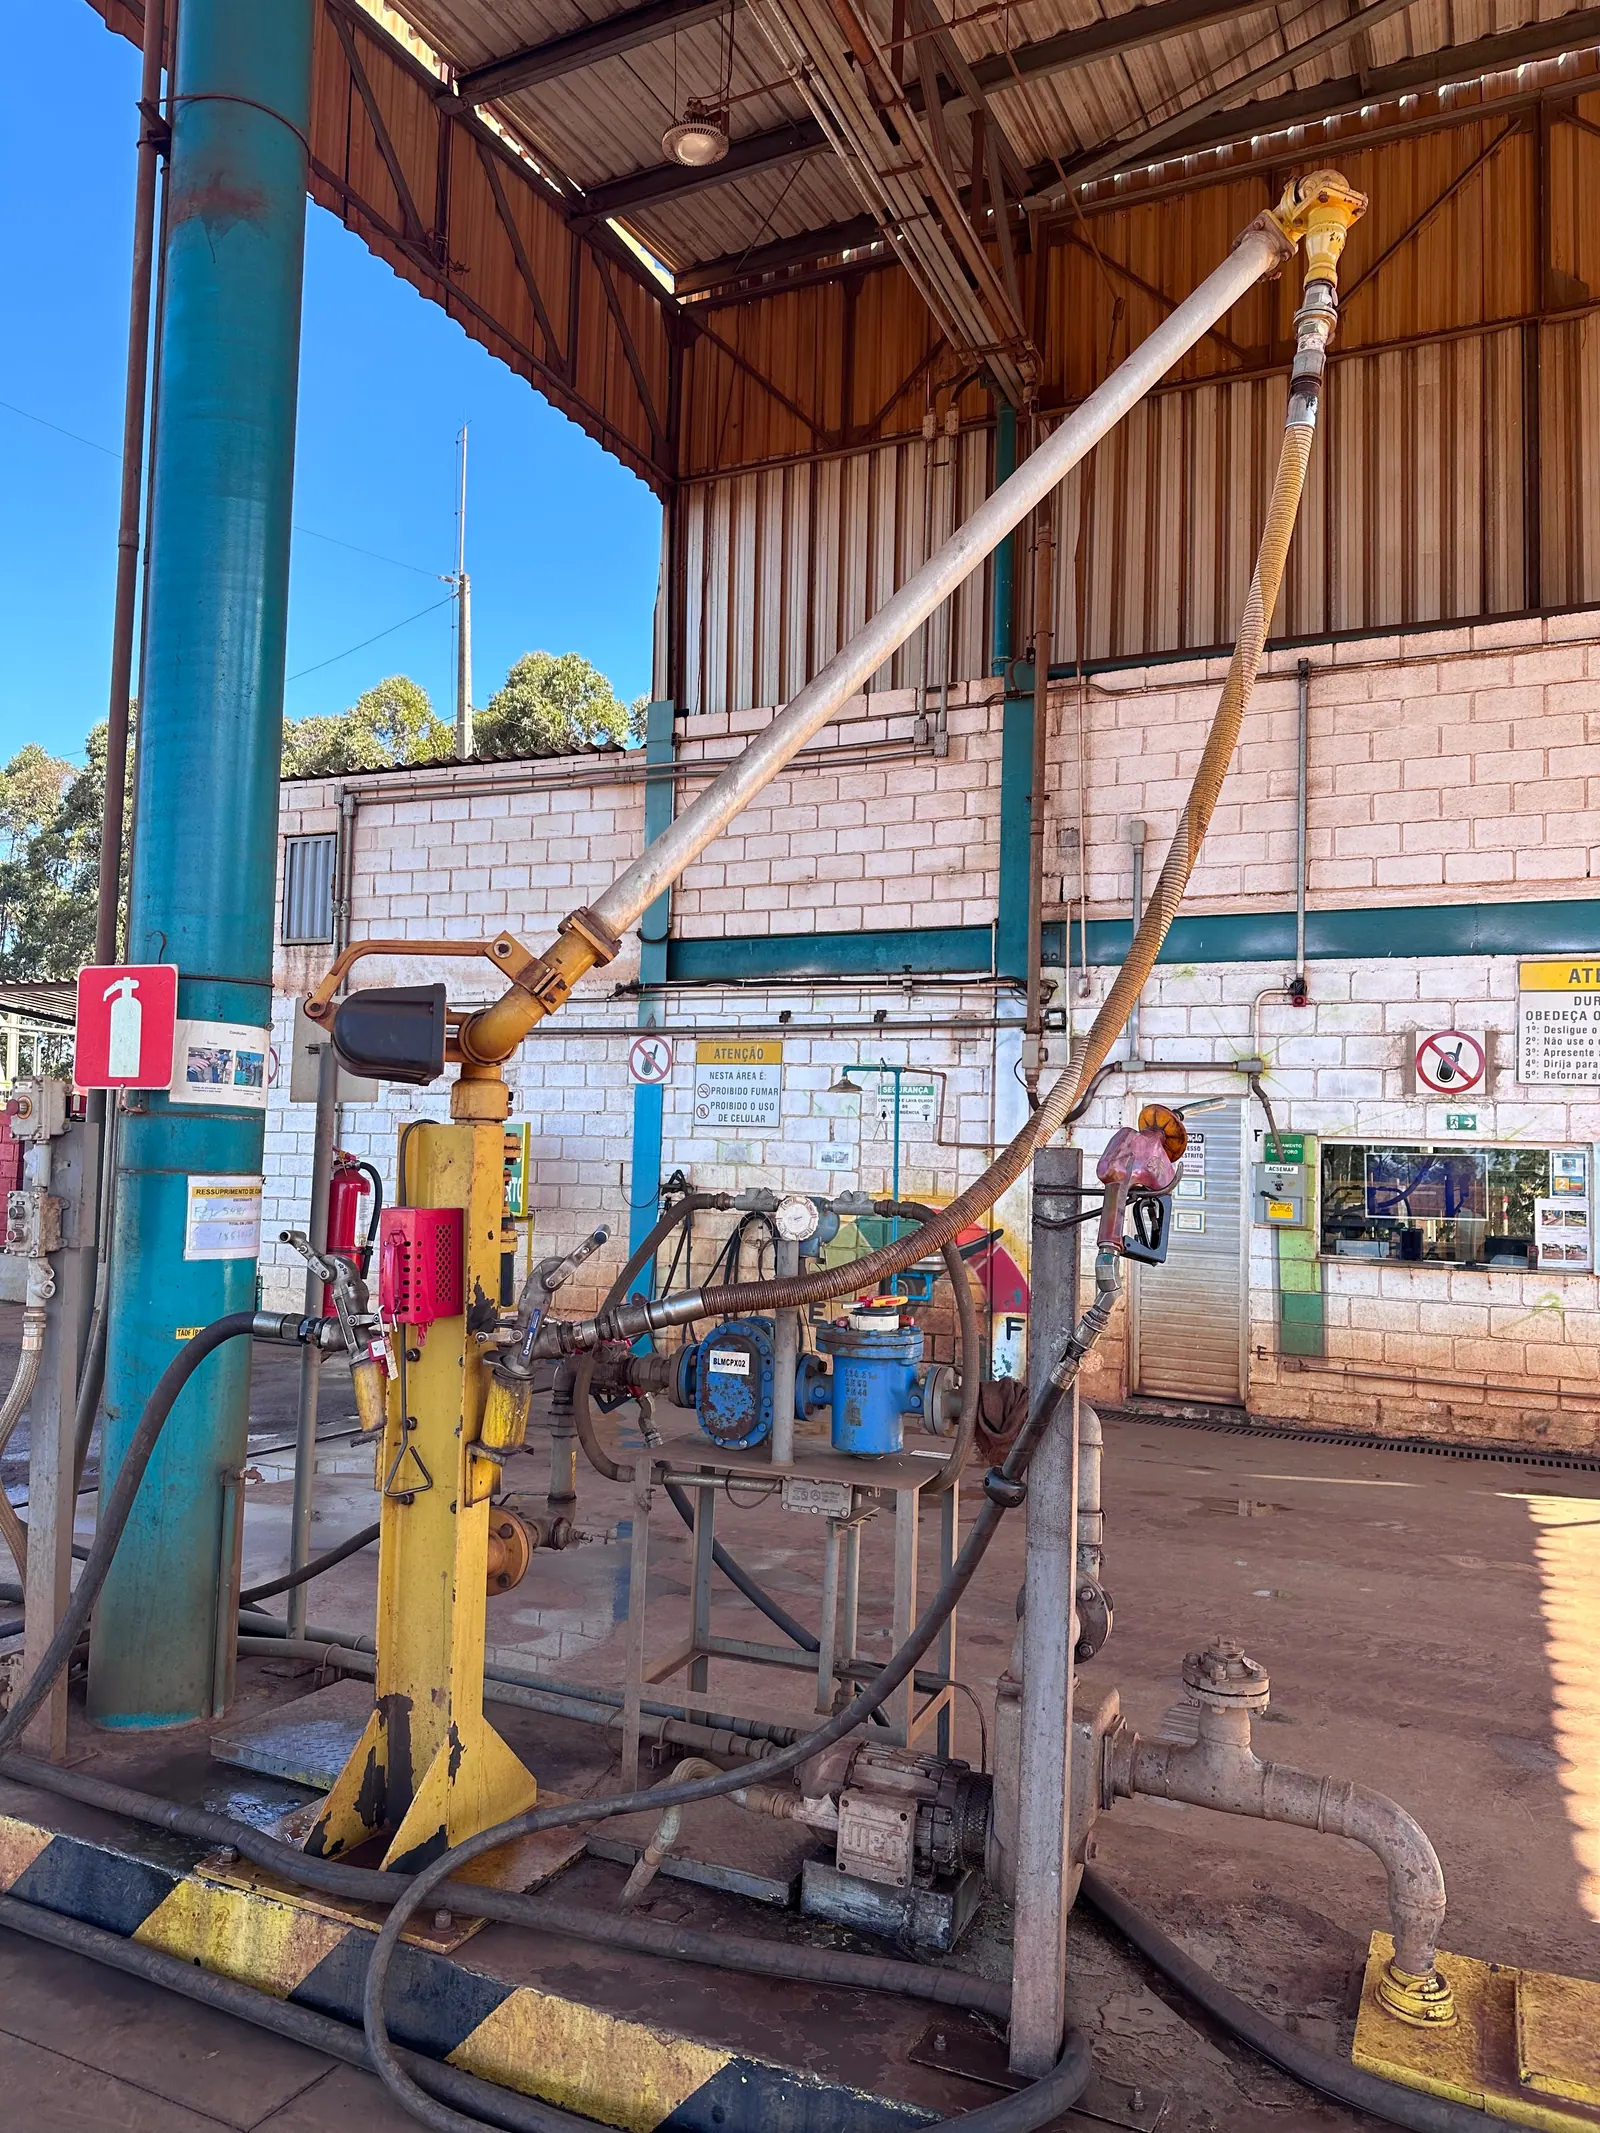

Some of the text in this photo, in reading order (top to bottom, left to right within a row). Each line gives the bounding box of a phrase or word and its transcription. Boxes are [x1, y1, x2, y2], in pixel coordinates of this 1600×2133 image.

[1525, 1010, 1588, 1023] OBEDEÇA
[1544, 1025, 1588, 1035] Desligue
[1543, 1036, 1563, 1046] Não
[1567, 1038, 1584, 1046] use
[1588, 1038, 1594, 1046] o
[714, 1046, 764, 1062] ATENÇÃO
[1543, 1048, 1595, 1058] Apresente
[1543, 1059, 1572, 1069] Dirija
[1575, 1061, 1598, 1069] para
[709, 1071, 734, 1080] NESTA
[736, 1070, 757, 1080] ÁREA
[711, 1086, 779, 1096] PROIBIDO FUMAR
[710, 1101, 775, 1111] PROIBIDO O USO
[718, 1113, 766, 1123] DE CELULAR
[1187, 1133, 1202, 1143] NÇÃO
[1254, 1129, 1263, 1142] F
[1559, 1179, 1566, 1189] 2
[809, 1301, 827, 1324] E
[1006, 1316, 1025, 1341] F
[713, 1357, 746, 1368] BLMCPX02
